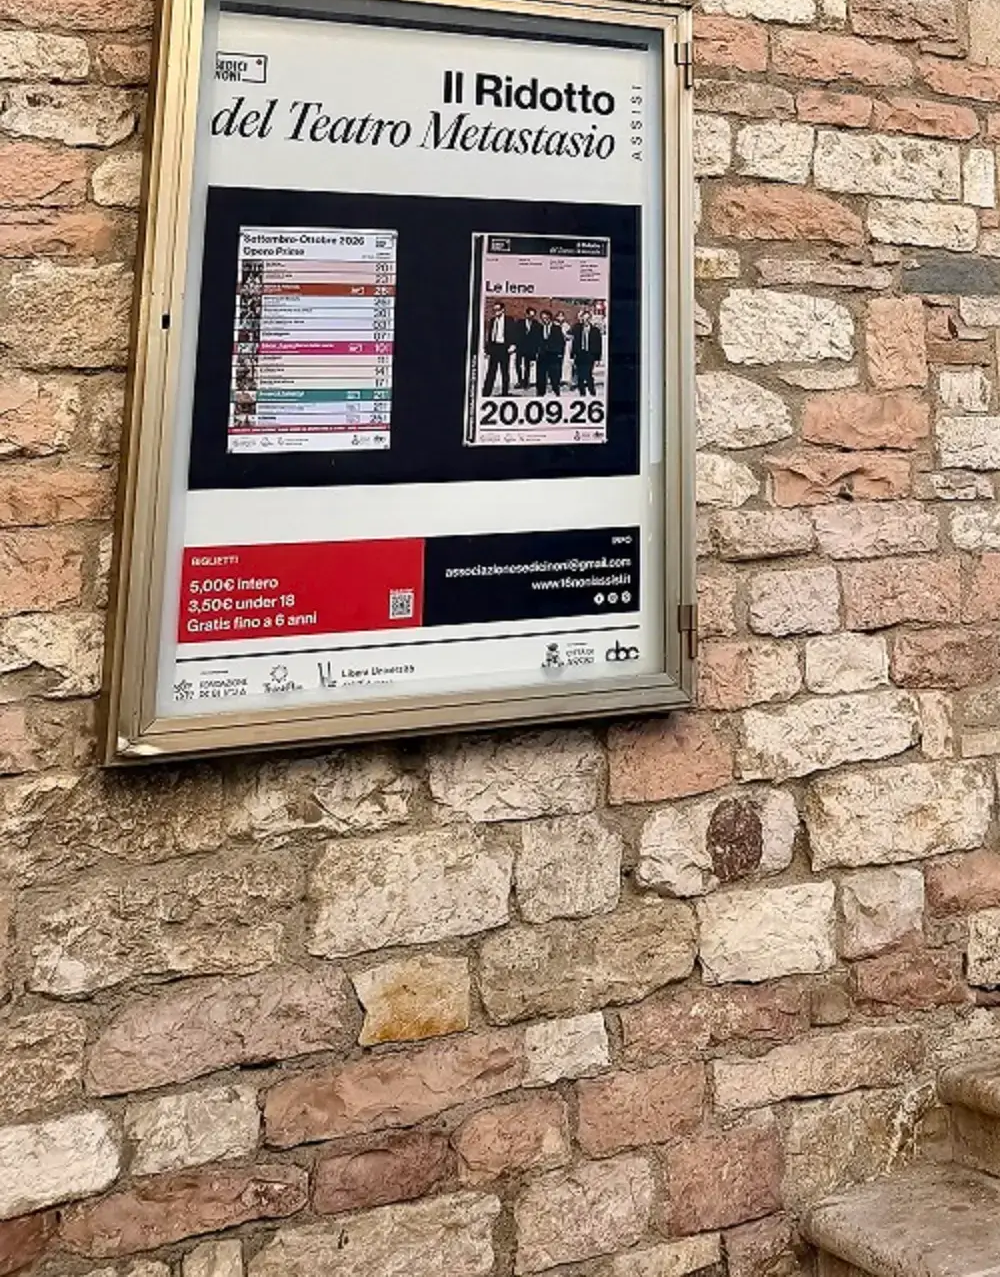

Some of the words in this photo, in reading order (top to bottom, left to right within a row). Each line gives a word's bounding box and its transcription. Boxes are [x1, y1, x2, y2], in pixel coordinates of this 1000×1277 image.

[443, 70, 465, 104] Il
[475, 72, 616, 116] Ridotto
[210, 96, 279, 138] del
[284, 101, 411, 148] Teatro
[416, 110, 616, 160] Metastasio
[631, 85, 643, 162] ASSISI
[485, 280, 502, 292] Le
[480, 400, 605, 425] 20.09.26
[189, 578, 235, 594] 5,00€
[237, 577, 279, 591] intero
[188, 597, 233, 614] 3,50€
[235, 594, 277, 610] under
[279, 593, 295, 608] 18
[187, 615, 231, 633] Gratis
[233, 615, 261, 630] fino
[263, 618, 272, 628] a
[275, 612, 285, 626] 6
[287, 610, 318, 627] anni
